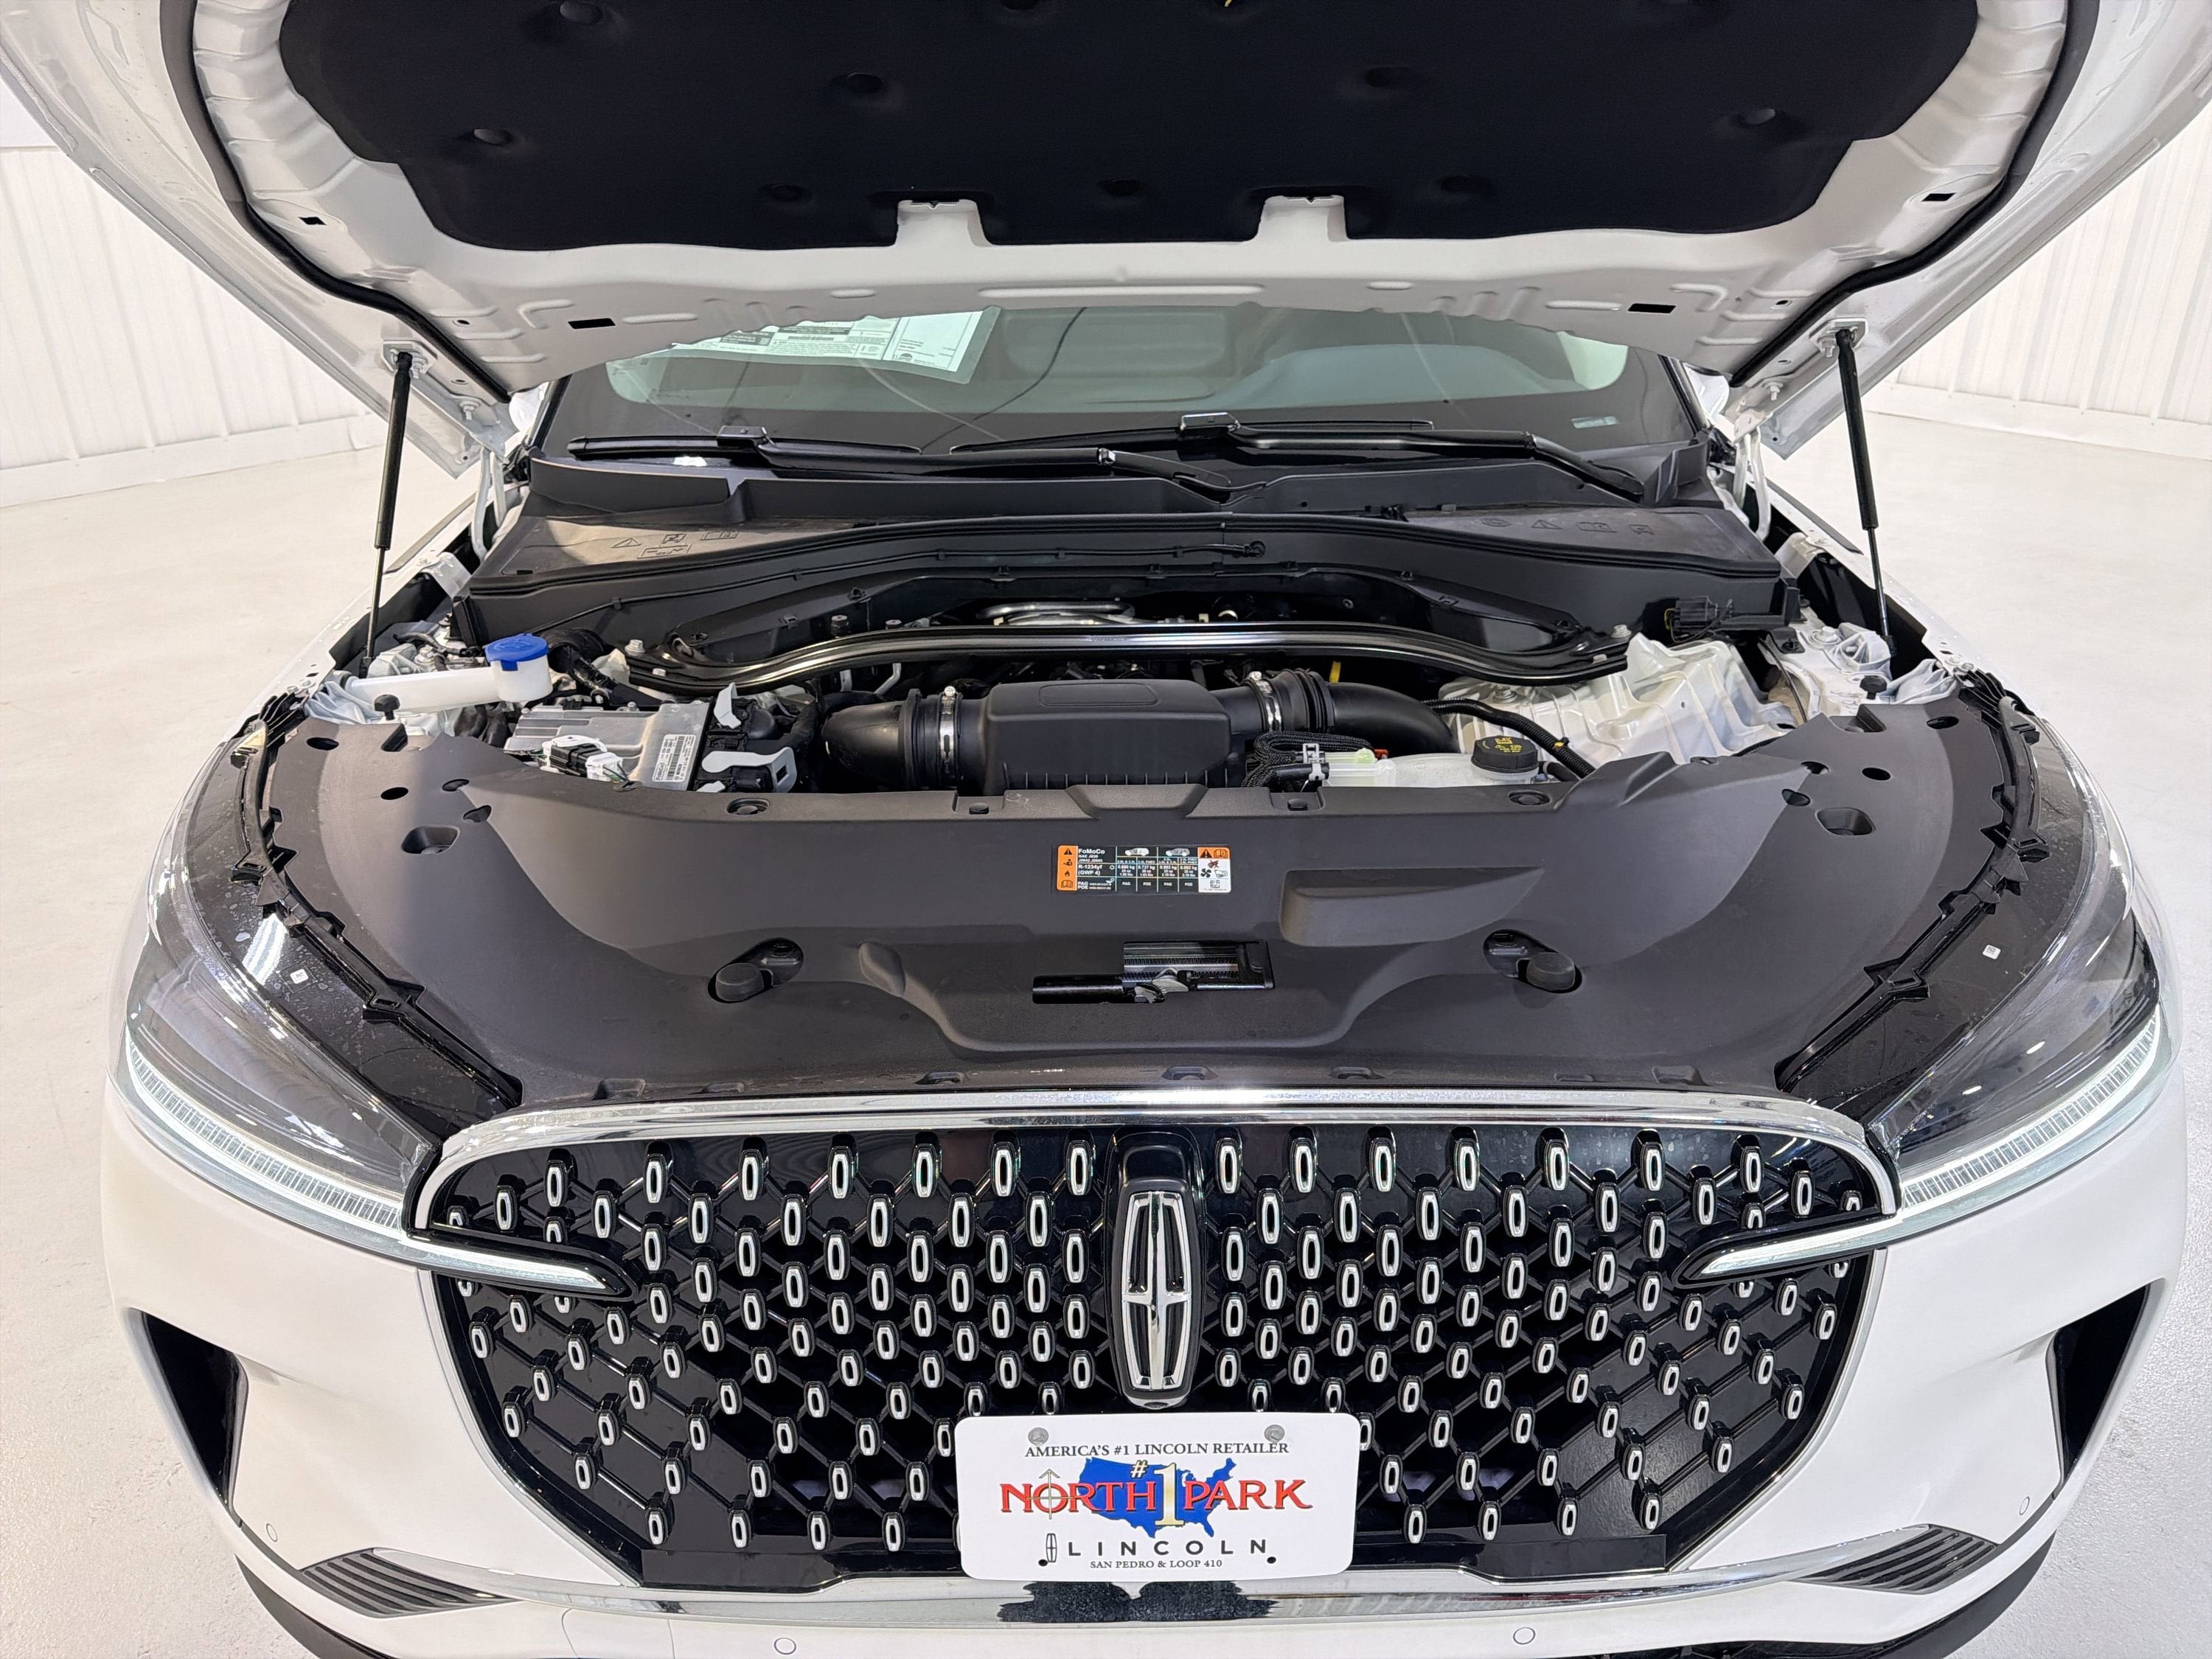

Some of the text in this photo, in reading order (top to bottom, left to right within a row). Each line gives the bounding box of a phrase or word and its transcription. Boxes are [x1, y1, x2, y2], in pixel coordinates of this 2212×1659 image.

[1025, 1442, 1290, 1457] AMERICA'S #1 LINCOLN RETAILER
[1000, 1479, 1314, 1514] NORTH PARK
[1068, 1539, 1267, 1557] LINCOLN
[1090, 1559, 1222, 1569] SAN PEDRO & LOOP 410
